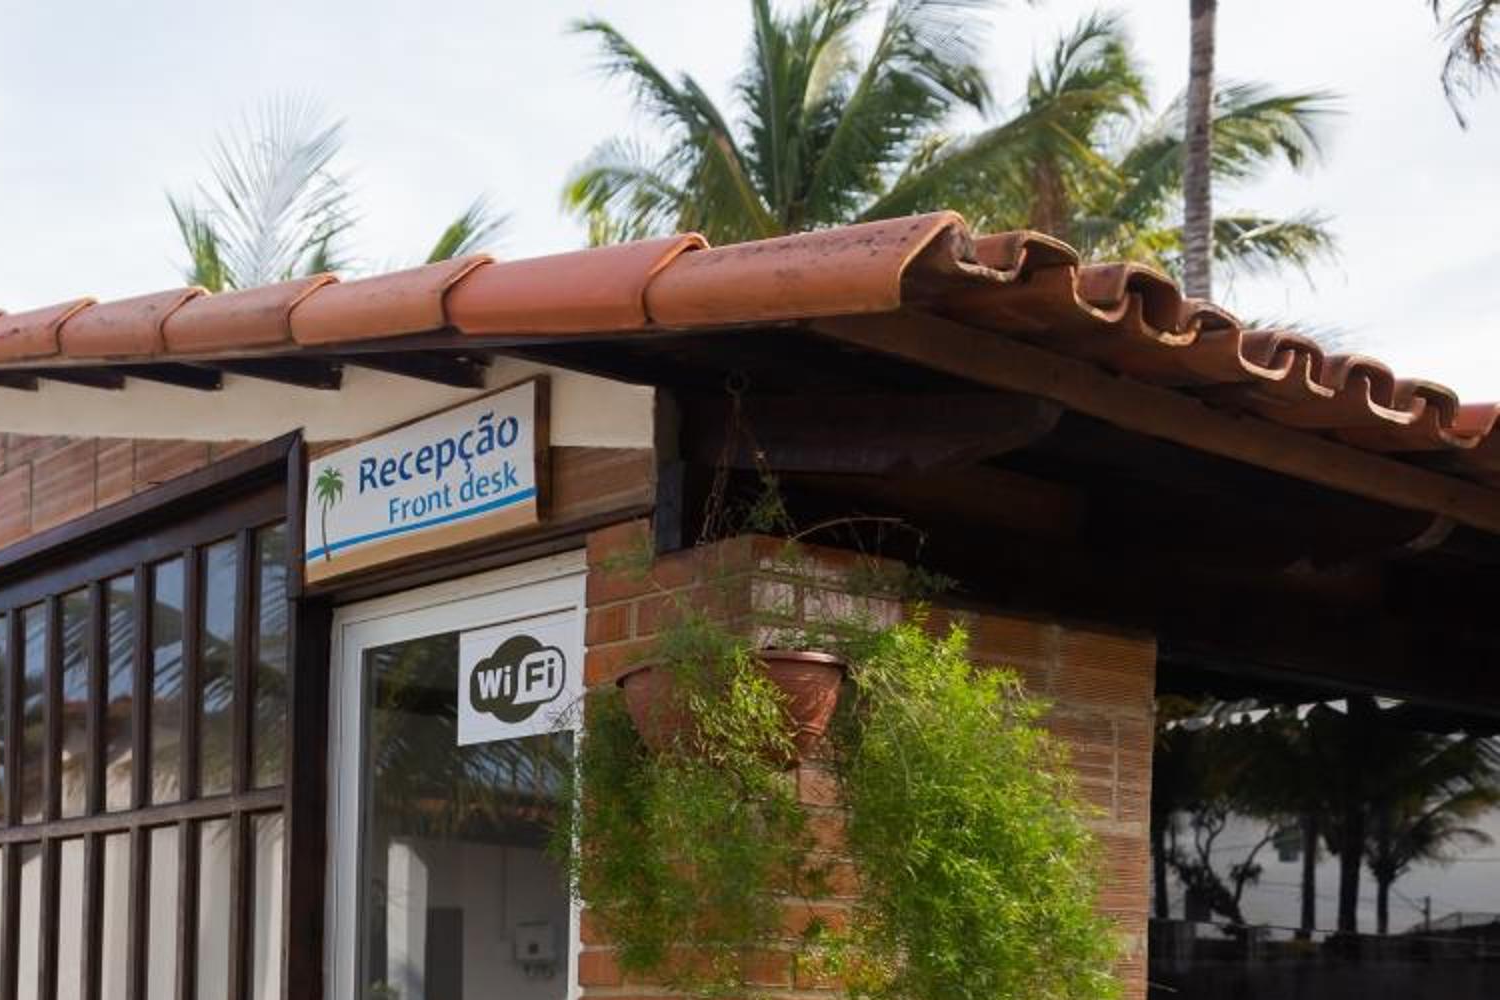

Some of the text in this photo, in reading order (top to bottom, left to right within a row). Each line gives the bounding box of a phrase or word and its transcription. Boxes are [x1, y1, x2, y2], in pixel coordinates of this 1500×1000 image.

[359, 411, 519, 495] Recepção
[389, 461, 519, 524] Front desk
